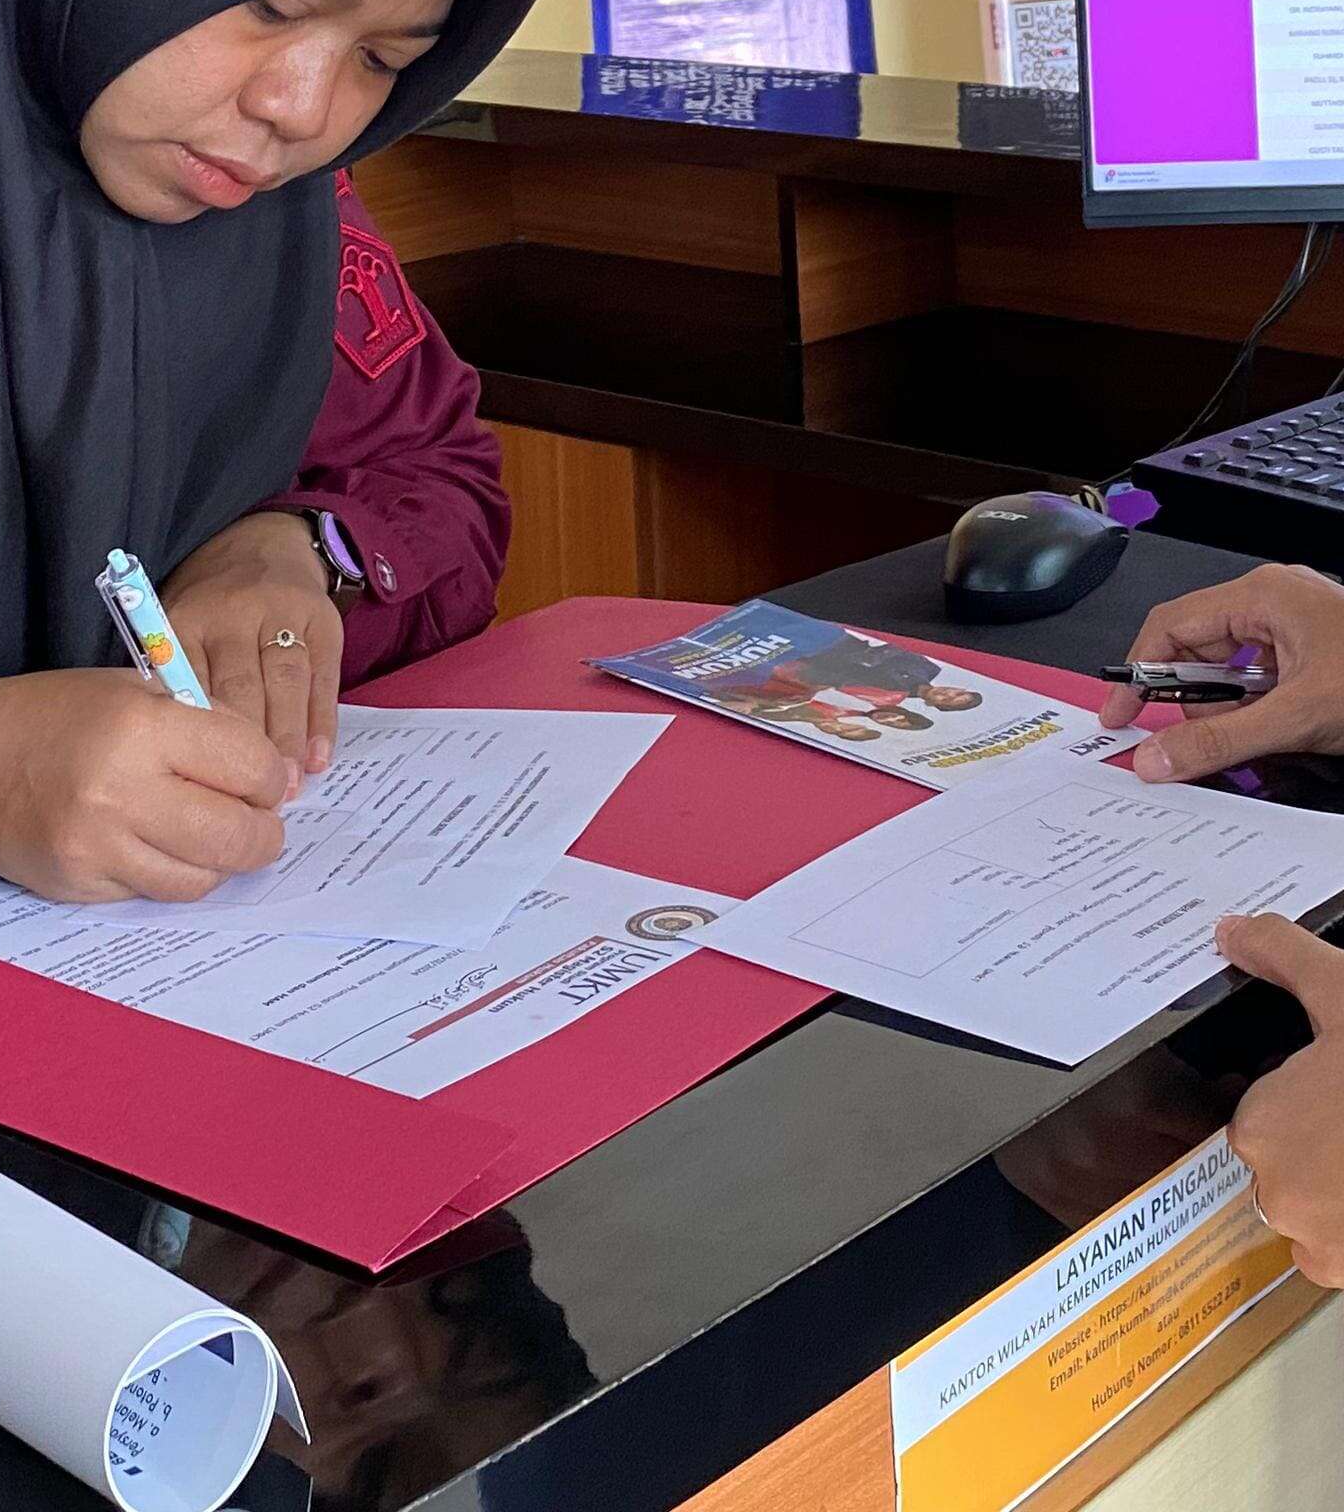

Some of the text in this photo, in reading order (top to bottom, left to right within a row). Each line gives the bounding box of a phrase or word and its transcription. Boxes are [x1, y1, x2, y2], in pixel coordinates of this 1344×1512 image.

[977, 510, 1029, 521] acer
[671, 634, 791, 679] HUKUM
[946, 710, 1060, 754] MAHASISWA
[483, 944, 617, 1014] S2 Magister Hukum
[546, 950, 664, 1005] UMKT
[1056, 1142, 1238, 1292] LAYANAN PENGADU
[939, 1172, 1242, 1409] KANTOR WILAYAH KEMENTERIAN HUKUM DAN HAM
[1156, 1306, 1181, 1334] atau
[1047, 1329, 1091, 1367] Website
[1091, 1374, 1134, 1411] Hubungi
[1137, 1339, 1172, 1376] Nomor
